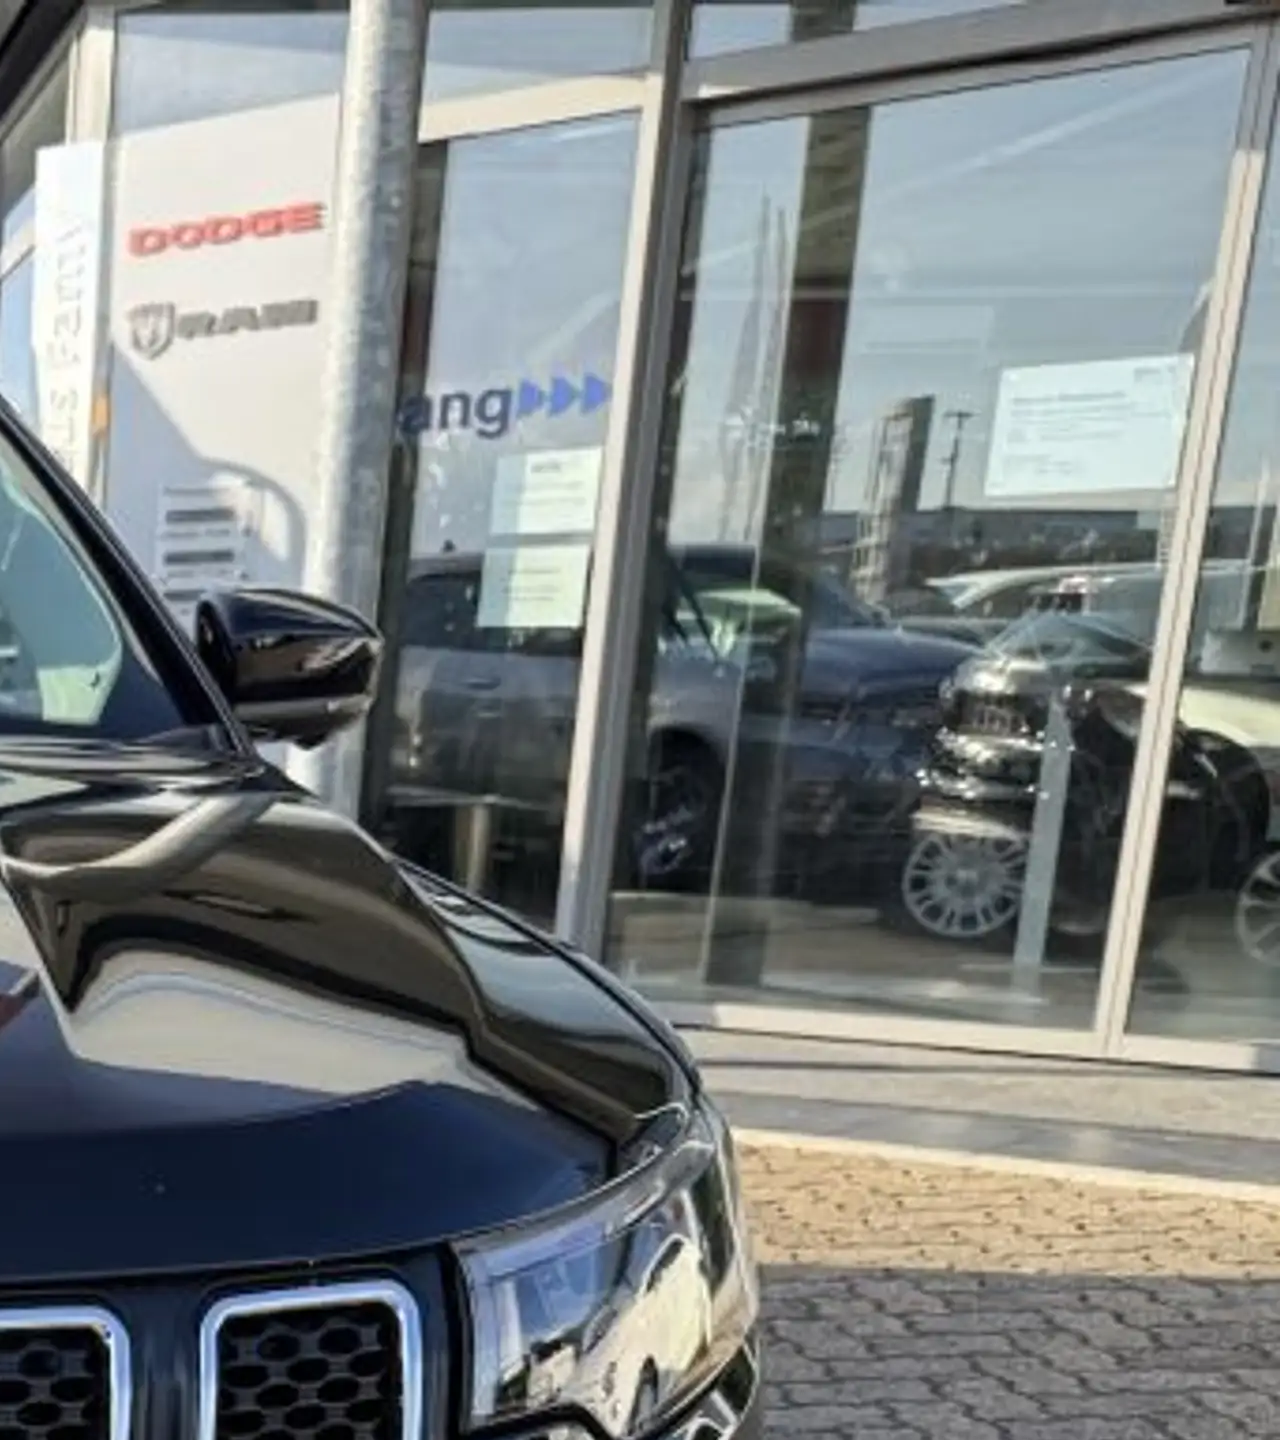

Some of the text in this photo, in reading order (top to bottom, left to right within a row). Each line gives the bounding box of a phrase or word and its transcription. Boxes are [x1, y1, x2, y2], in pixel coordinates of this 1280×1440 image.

[130, 202, 326, 257] DODGE
[178, 299, 318, 340] RAM
[397, 386, 513, 440] ang
